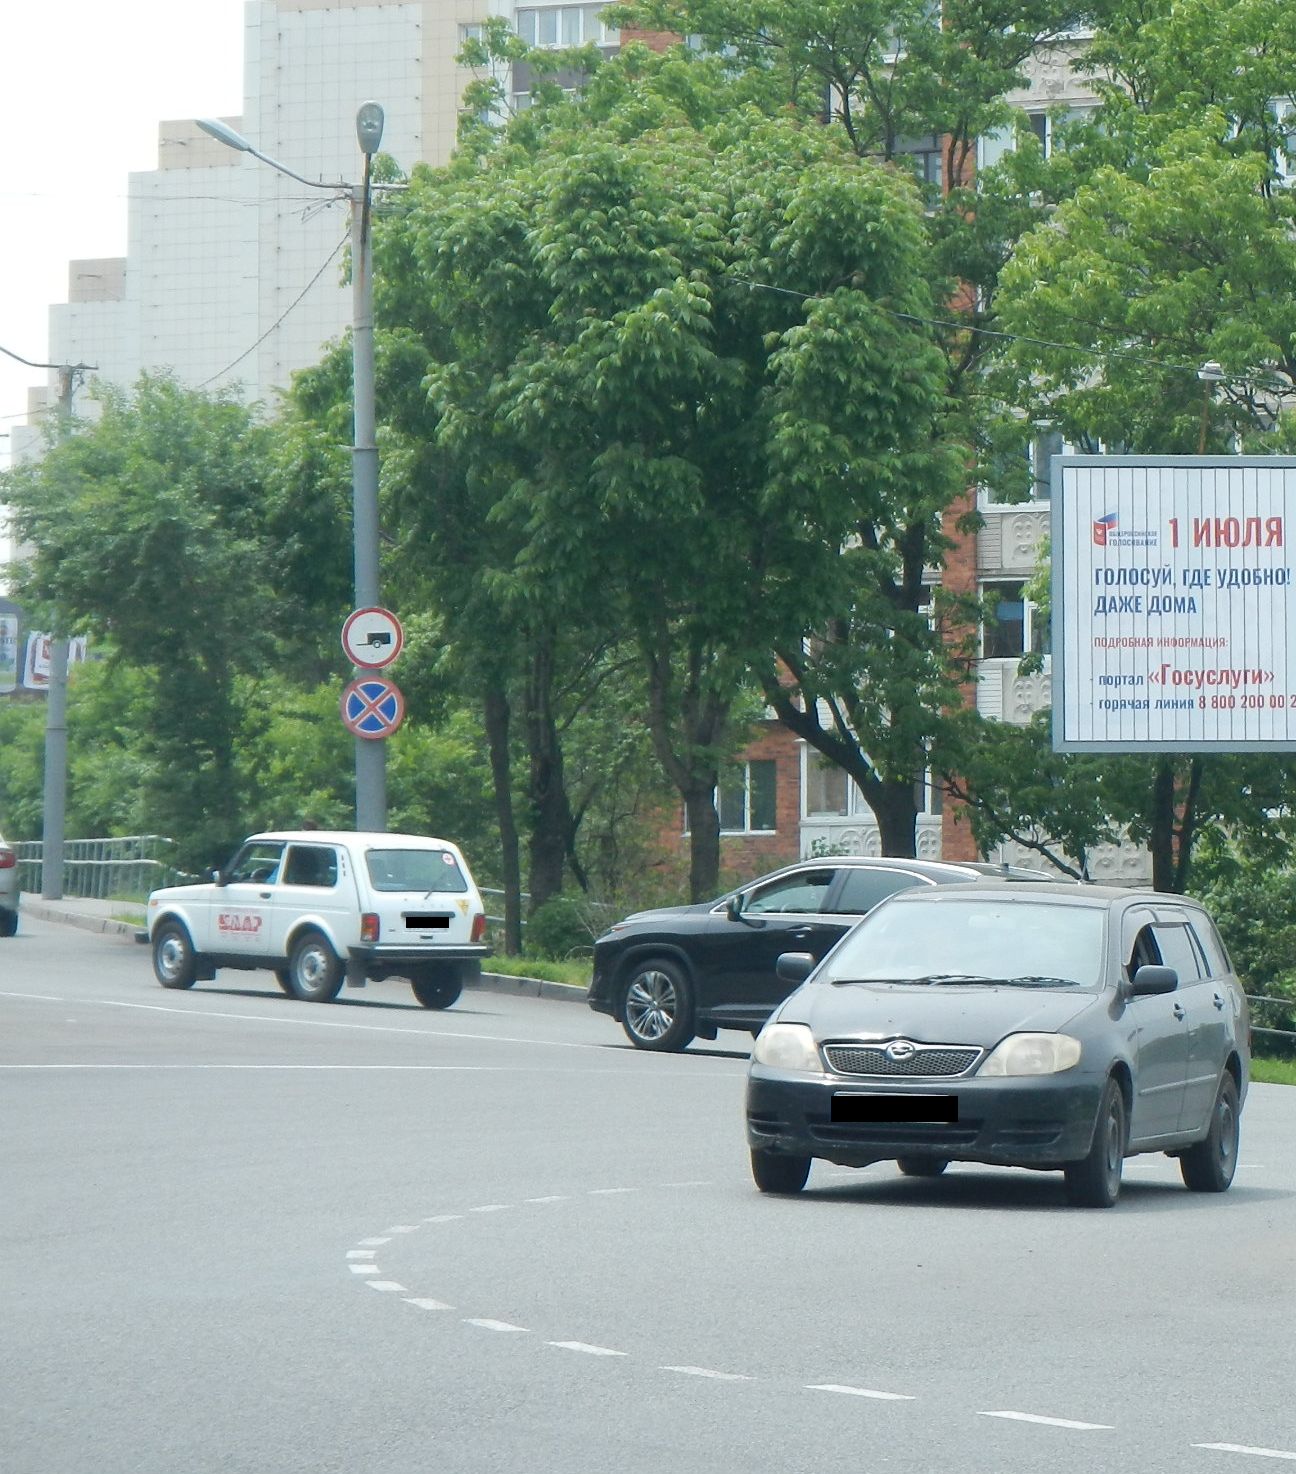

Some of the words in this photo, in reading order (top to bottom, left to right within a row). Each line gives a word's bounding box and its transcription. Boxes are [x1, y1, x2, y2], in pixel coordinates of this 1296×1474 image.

[1169, 517, 1178, 548] 1
[1193, 516, 1283, 548] ИЮЛЯ
[1095, 564, 1177, 589] ГОЛОСУЙ,
[1183, 569, 1211, 589] ГДЕ
[1218, 568, 1291, 589] УДОБНО!
[1094, 596, 1142, 616] ДАЖЕ
[1147, 596, 1197, 616] ДОМА
[1094, 637, 1153, 648] ПОДРОБНАЯ
[1157, 637, 1229, 649] ИНФОРМАЦИЯ:
[1099, 674, 1144, 686] портал
[1148, 664, 1275, 690] «Госуслуги»
[1099, 698, 1150, 712] горячая
[1155, 699, 1194, 709] линия
[1199, 696, 1206, 710] 8
[1211, 696, 1235, 709] 800
[1241, 696, 1265, 709] 200
[1269, 696, 1286, 708] 00
